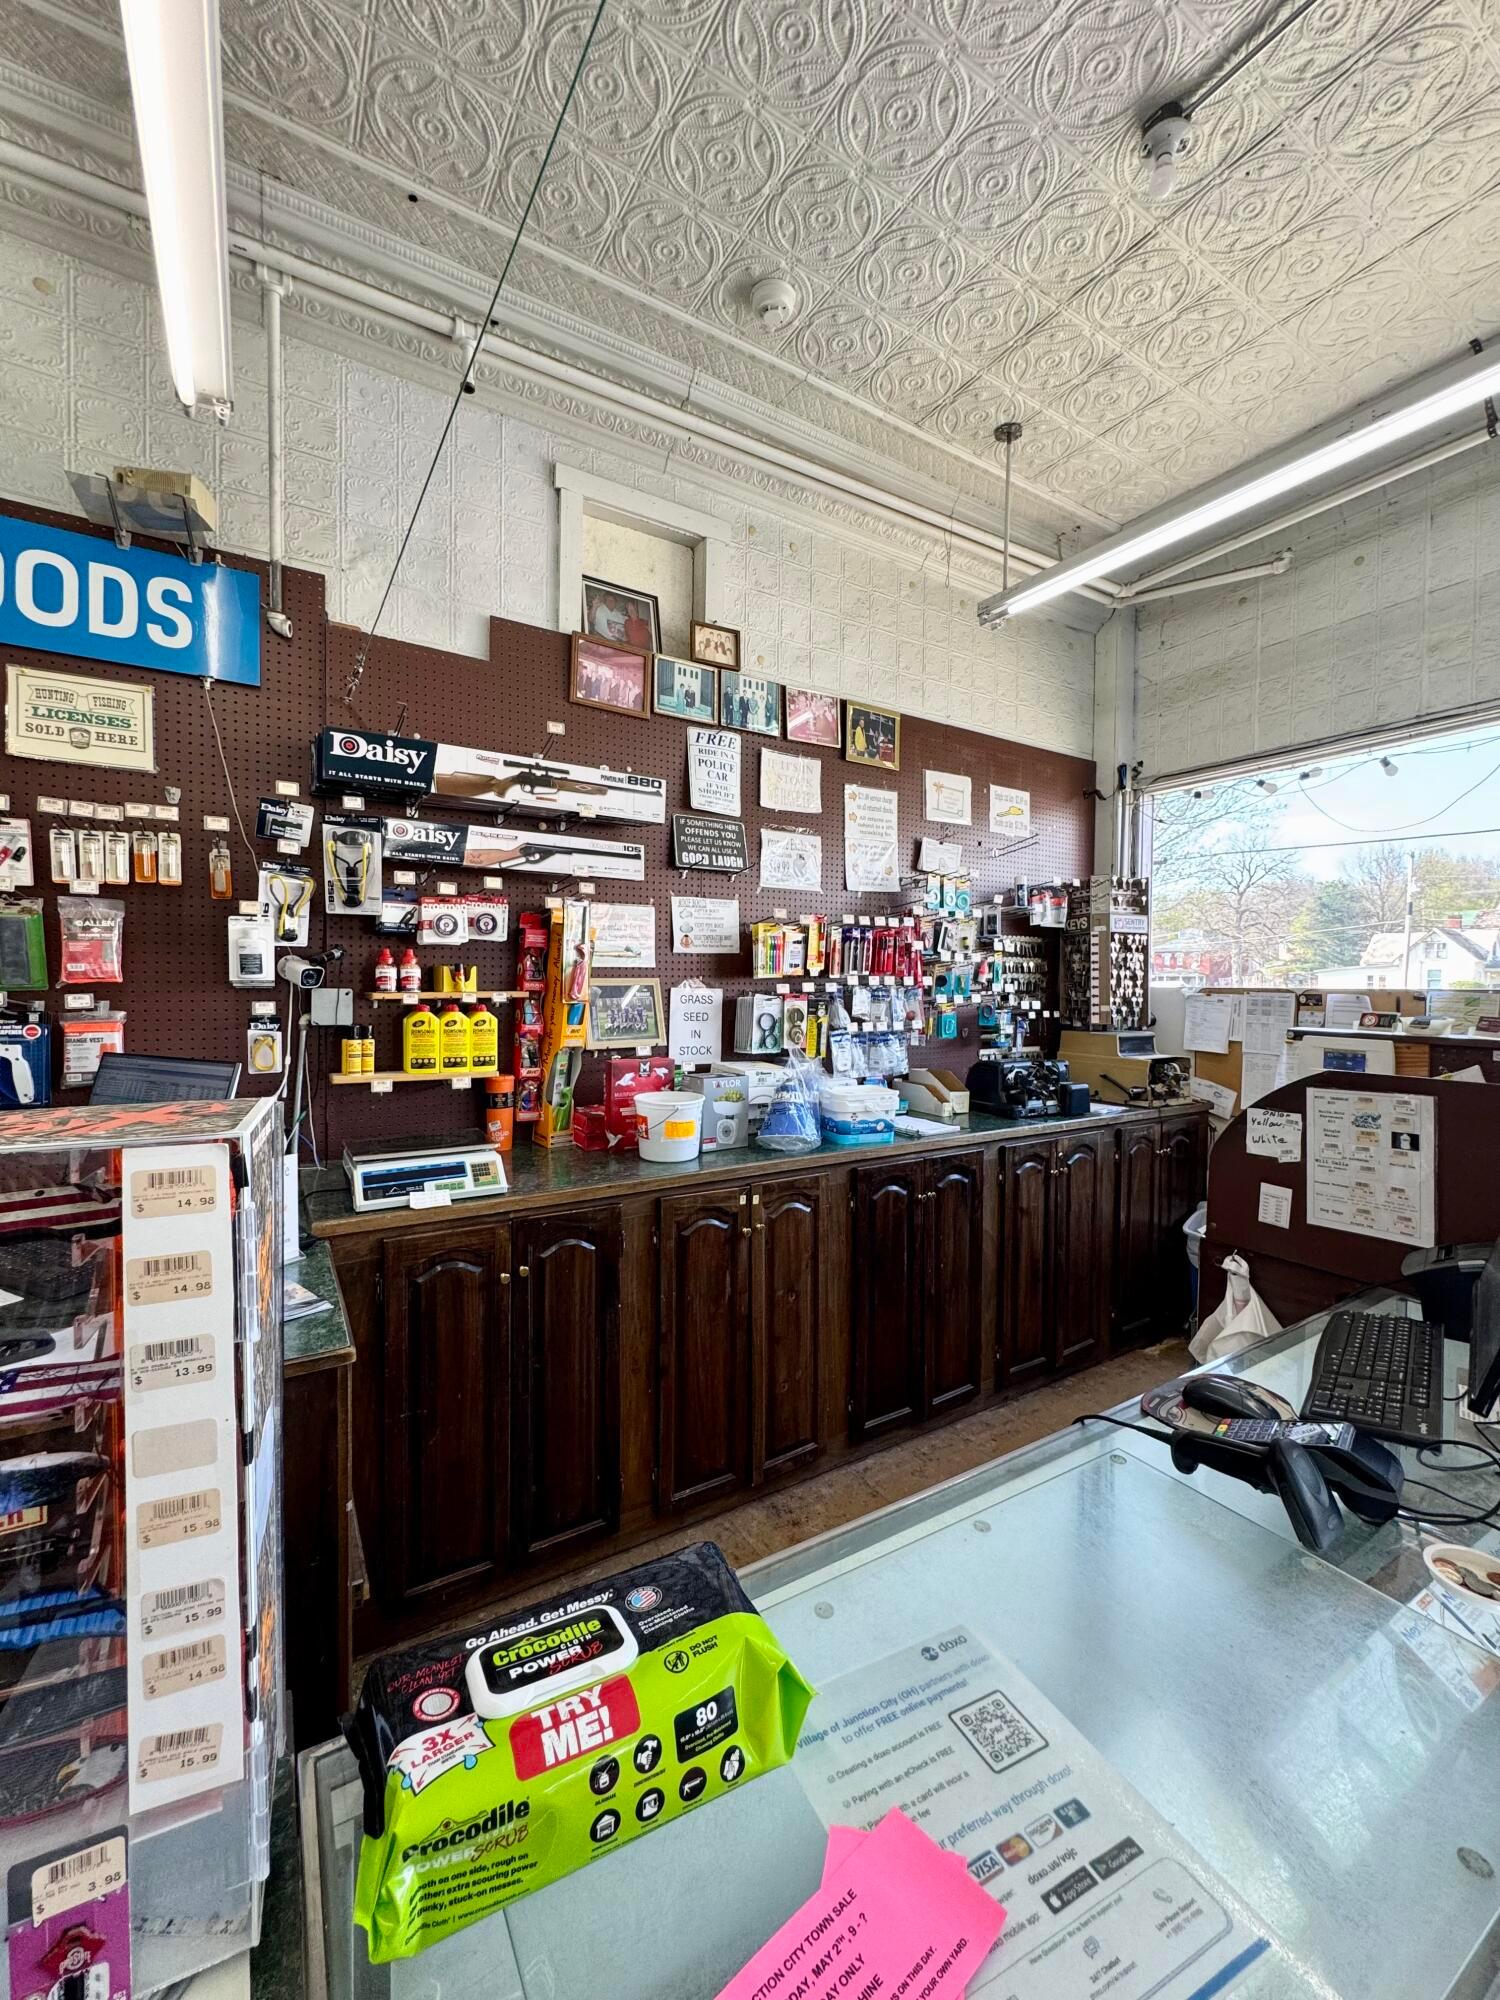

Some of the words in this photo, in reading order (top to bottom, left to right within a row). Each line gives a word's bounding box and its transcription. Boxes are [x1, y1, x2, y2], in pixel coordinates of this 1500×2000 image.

[0, 549, 193, 648] ODS
[34, 687, 75, 703] HUNTING
[92, 695, 127, 711] FISHING
[31, 706, 132, 729] LICENSES
[25, 722, 65, 737] SOLD
[94, 731, 138, 746] HERE
[695, 731, 737, 750] FREE
[329, 731, 427, 774] Daisy
[698, 748, 719, 757] RIDE
[355, 773, 381, 781] STARTS
[698, 758, 736, 774] POLICE
[707, 770, 728, 782] CAR
[600, 774, 624, 784] POWERLINE
[627, 775, 662, 789] 880
[698, 787, 736, 799] SHOPLIFT
[714, 783, 731, 791] YOU
[261, 803, 289, 816] Daisy
[385, 820, 460, 851] Daisy
[685, 827, 718, 838] OFFENDS
[721, 831, 737, 839] YOU
[687, 819, 723, 830] SOMETHING
[681, 836, 701, 845] PLEASE
[703, 838, 713, 846] LET
[723, 840, 741, 848] KNOW
[682, 852, 709, 865] GOOD
[713, 854, 743, 868] LAUGH
[1066, 917, 1088, 931] KEYS
[680, 994, 714, 1005] GRASS
[250, 1022, 280, 1032] Daisy
[683, 1012, 709, 1022] SEED
[690, 1029, 700, 1038] IN
[679, 1046, 712, 1056] STOCK
[712, 1079, 741, 1088] TAYLOR
[137, 1204, 144, 1213] $
[177, 1197, 215, 1207] 14.98
[133, 1291, 141, 1300] $
[174, 1282, 211, 1294] 14.98
[135, 1376, 143, 1385] $
[175, 1363, 213, 1377] 13.99
[142, 1535, 151, 1543] $
[183, 1518, 220, 1533] 15.98
[145, 1625, 153, 1635] $
[185, 1607, 222, 1623] 15.99
[465, 1636, 487, 1649] Go
[489, 1618, 538, 1641] Ahead.
[540, 1608, 565, 1624] Get
[638, 1608, 674, 1626] Oversized,
[643, 1618, 673, 1634] Cleaning
[492, 1618, 601, 1667] Crocodile
[560, 1633, 593, 1650] CLOTH
[689, 1642, 701, 1651] DO
[701, 1635, 717, 1645] NOT
[693, 1642, 718, 1657] FLUSH
[938, 1635, 967, 1653] doxo
[509, 1645, 583, 1679] POWER
[550, 1640, 603, 1675] SCRUB
[148, 1685, 157, 1694] $
[189, 1664, 225, 1681] 14.98
[530, 1684, 602, 1729] TRY
[696, 1701, 717, 1727] 80
[797, 1730, 829, 1749] Village
[830, 1722, 840, 1733] of
[842, 1706, 880, 1728] Junction
[879, 1696, 898, 1711] City
[899, 1685, 919, 1704] (OH)
[918, 1673, 952, 1694] partners
[952, 1663, 970, 1675] with
[841, 1734, 853, 1744] to
[854, 1723, 875, 1739] offer
[875, 1711, 900, 1729] FREE
[901, 1700, 927, 1716] online
[927, 1679, 968, 1704] payments!
[422, 1727, 457, 1751] 3X
[541, 1705, 614, 1767] ME!
[410, 1731, 475, 1768] LARGER
[836, 1760, 867, 1780] Creating
[873, 1749, 891, 1761] doxo
[891, 1735, 918, 1752] account
[923, 1721, 943, 1733] FREE
[140, 1768, 148, 1778] $
[180, 1753, 217, 1768] 15.99
[852, 1789, 879, 1805] Paying
[878, 1779, 894, 1791] with
[904, 1761, 931, 1778] eCheck
[935, 1747, 956, 1759] FREE
[916, 1789, 934, 1803] card
[933, 1781, 946, 1793] will
[944, 1775, 963, 1787] incur
[918, 1808, 931, 1819] fee
[948, 1814, 993, 1847] preferred
[994, 1800, 1013, 1817] way
[1011, 1779, 1048, 1806] through
[1047, 1765, 1073, 1786] doxo!
[402, 1800, 530, 1863] Crocodile
[471, 1823, 528, 1863] SCRUB
[438, 1876, 449, 1885] on
[451, 1871, 468, 1881] one
[469, 1864, 490, 1876] side,
[491, 1856, 516, 1870] rough
[517, 1853, 528, 1861] on
[446, 1883, 470, 1895] extra
[471, 1869, 509, 1886] scouring
[510, 1861, 538, 1877] power
[969, 1855, 999, 1880] VISA
[1028, 1847, 1078, 1885] doxo.us/vojc
[37, 1904, 44, 1915] $
[88, 1872, 121, 1892] 3.98
[448, 1890, 487, 1906] stuck-on
[489, 1877, 523, 1893] messes.
[1062, 1886, 1077, 1902] App
[1073, 1875, 1093, 1894] Store
[783, 1946, 807, 1972] CITY
[804, 1914, 835, 1948] TOWN
[832, 1888, 858, 1917] SALE
[1003, 1923, 1027, 1944] mobile
[811, 1953, 835, 1980] MAY
[848, 1925, 858, 1937] 9
[859, 1912, 869, 1924] ?
[838, 1953, 866, 1987] ONLY
[898, 1979, 910, 1992] ON
[907, 1962, 924, 1984] THIS
[921, 1945, 938, 1965] DAY.
[918, 1976, 939, 2000] YOUR
[936, 1961, 954, 1981] OWN
[948, 1937, 971, 1966] YARD.
